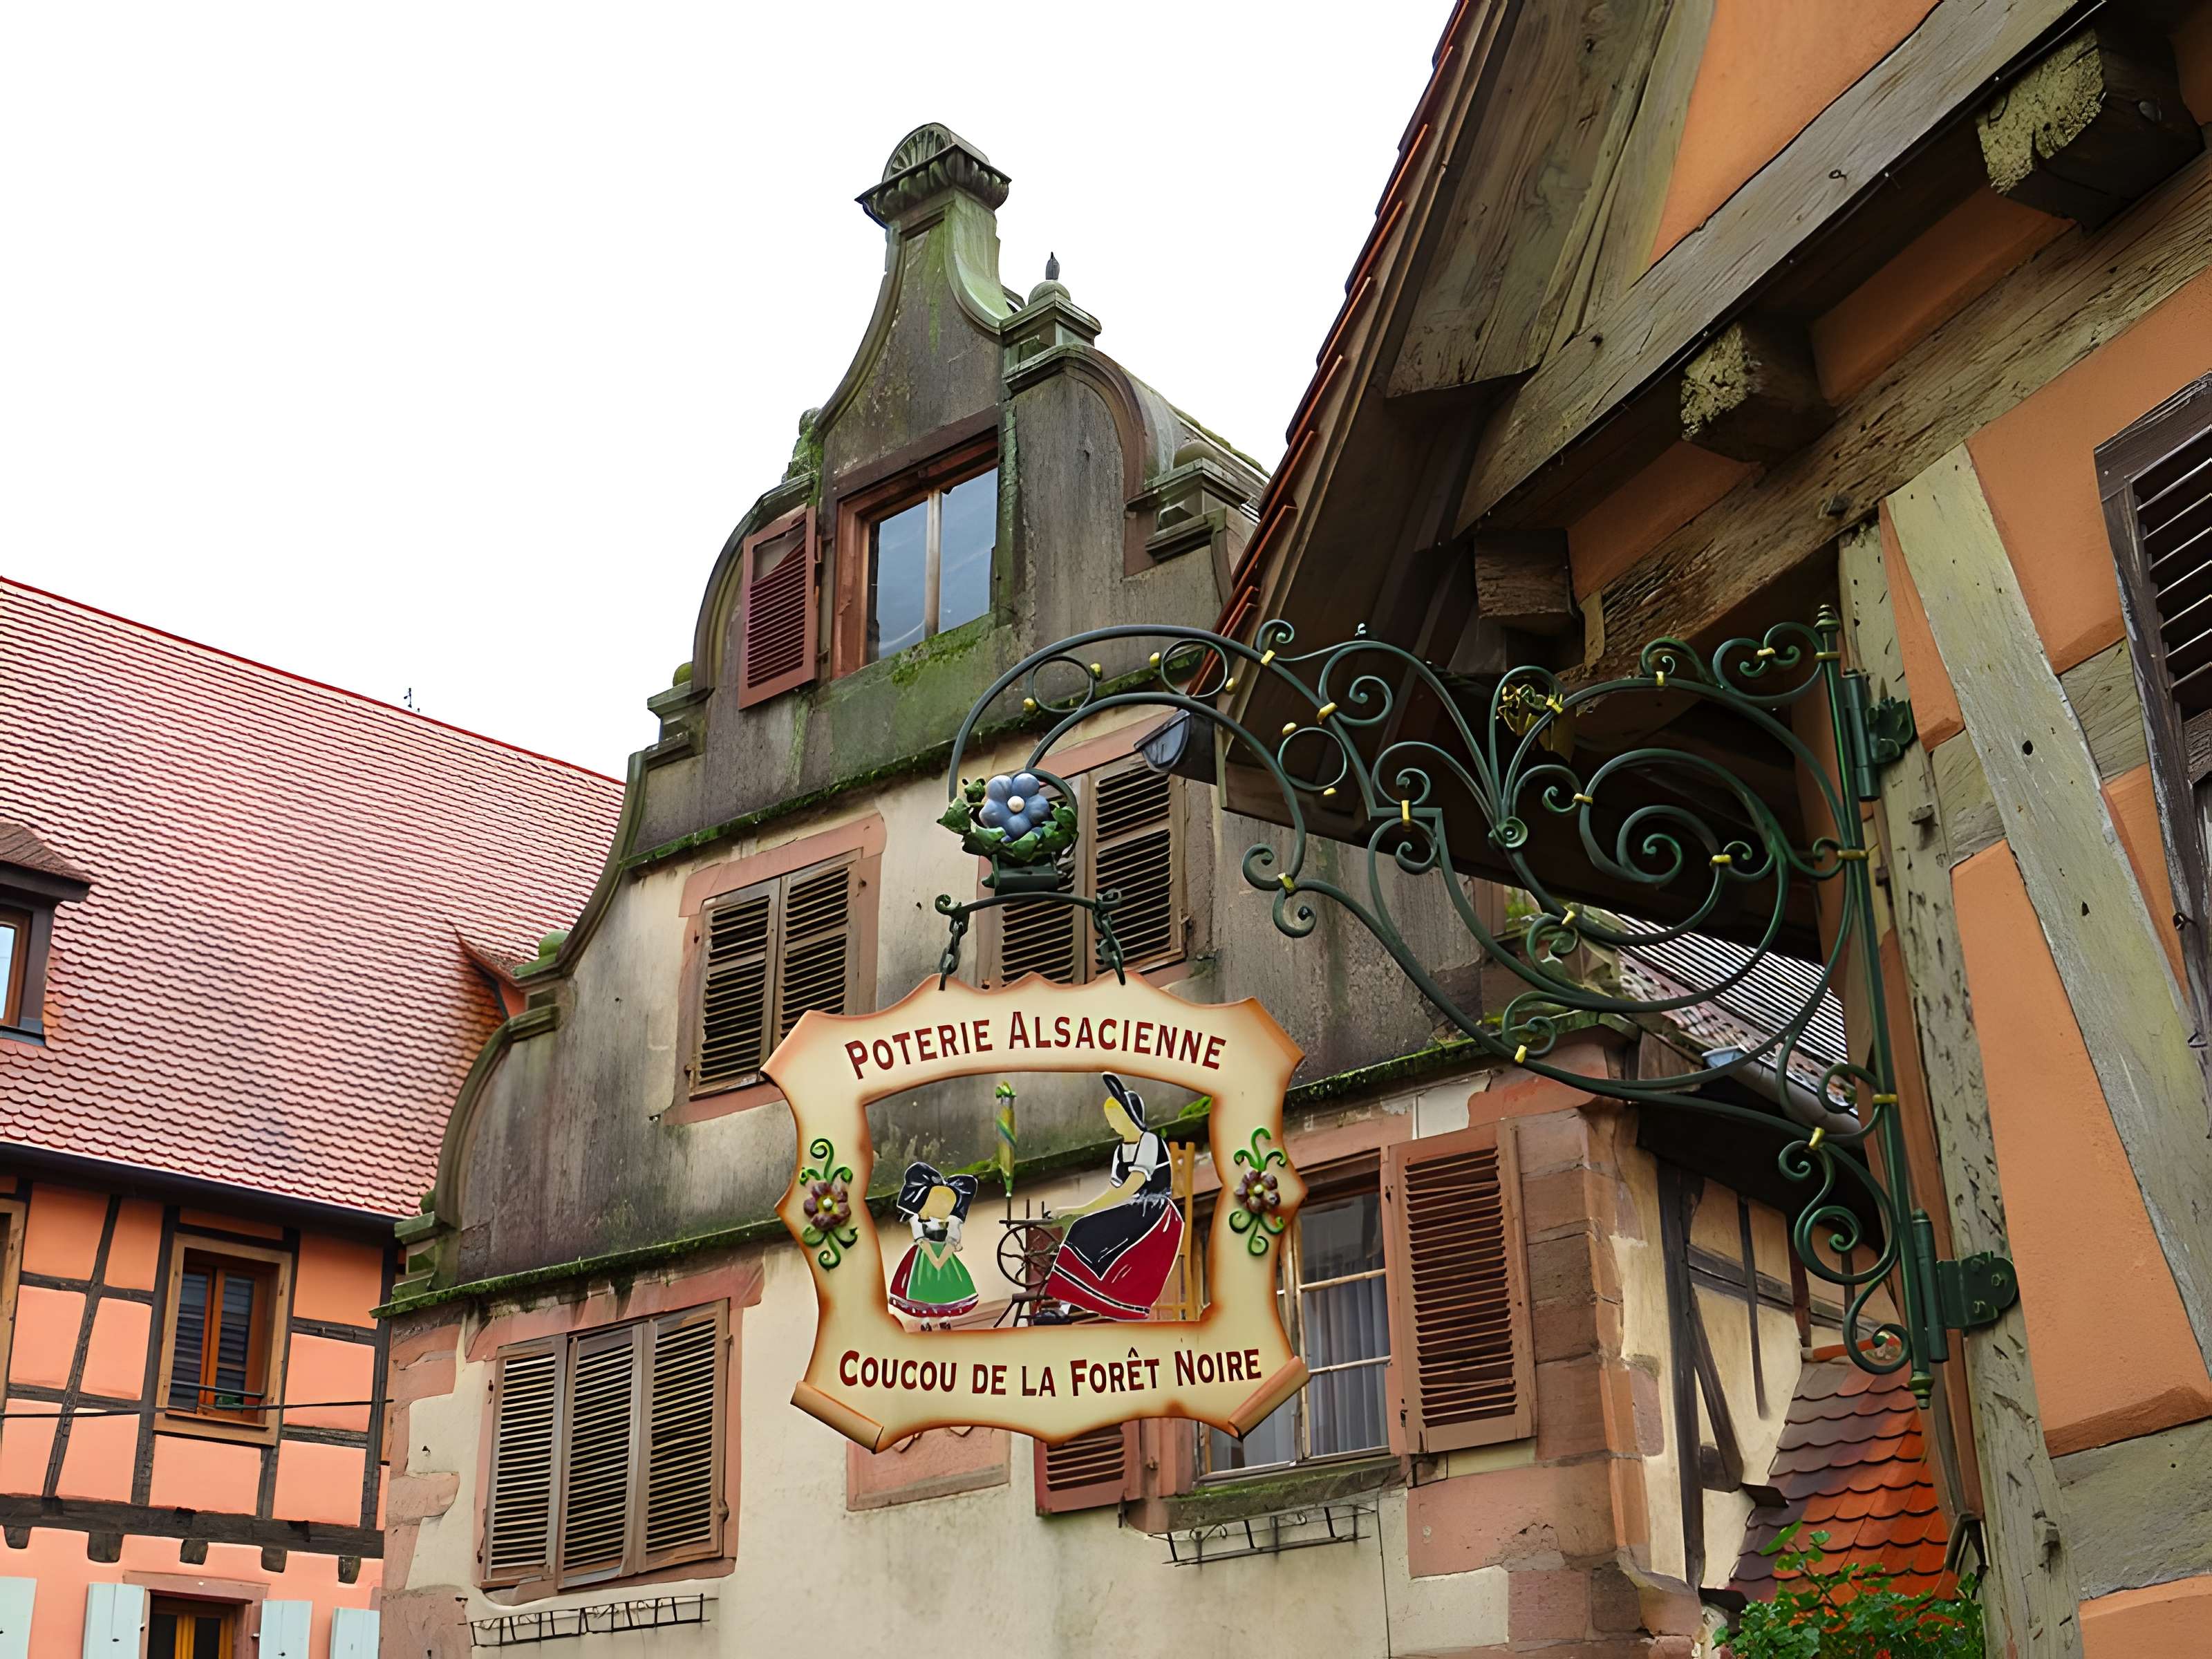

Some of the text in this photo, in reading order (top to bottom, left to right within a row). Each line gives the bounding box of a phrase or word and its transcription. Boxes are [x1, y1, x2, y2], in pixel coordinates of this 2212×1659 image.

[844, 1011, 1226, 1080] POTERIE ALSACIENNE
[839, 1347, 1262, 1397] COUCOU DE LA FORÊT NOIRE
